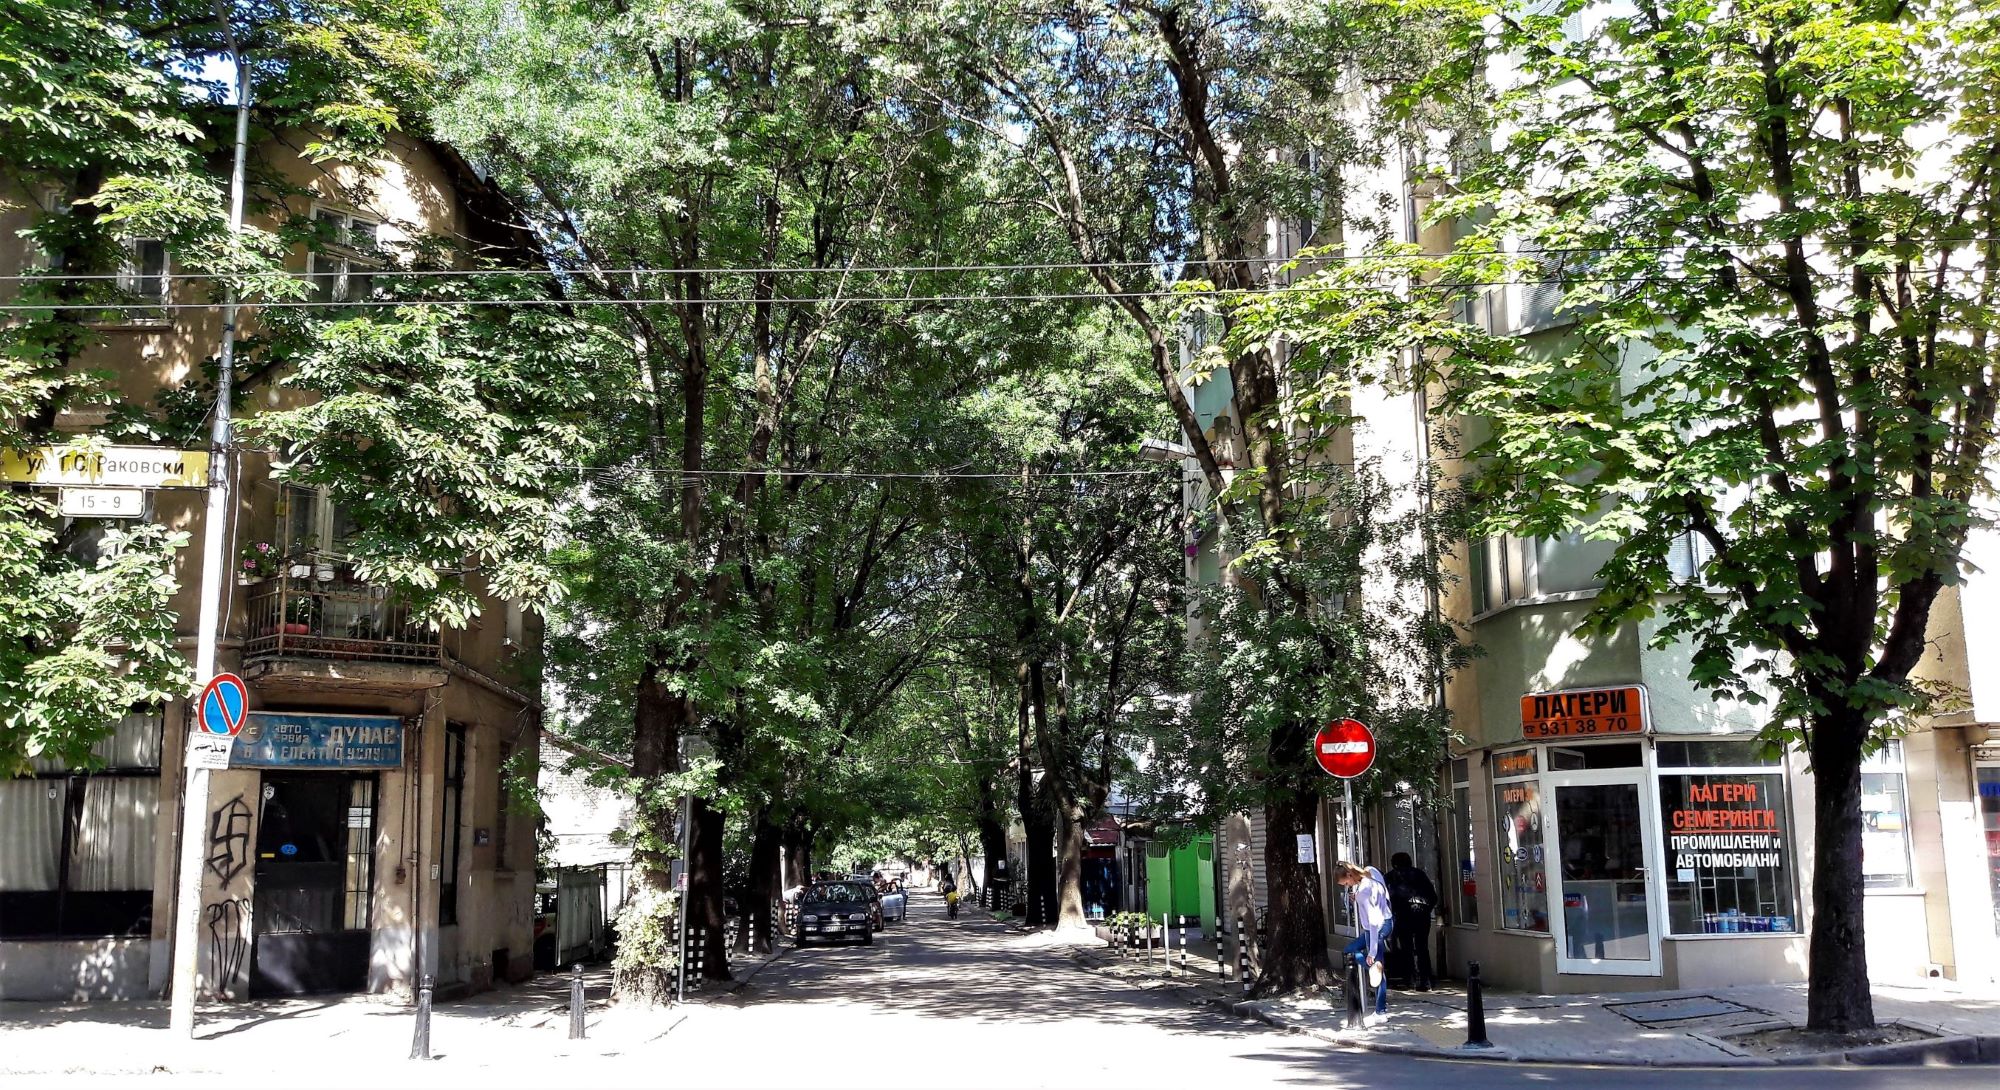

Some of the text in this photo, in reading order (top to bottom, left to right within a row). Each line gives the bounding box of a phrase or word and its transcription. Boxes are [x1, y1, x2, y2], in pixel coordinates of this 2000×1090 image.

[97, 455, 184, 475] Раковски
[82, 495, 95, 509] 15
[113, 496, 121, 509] 9
[1534, 690, 1627, 719] ЛАГЕРИ
[330, 725, 394, 745] ДУНАВ
[1540, 717, 1628, 735] 931 38 70
[1689, 784, 1757, 803] ЛАГЕРИ
[1672, 809, 1777, 828] СЕМЕРИНГИ
[1671, 835, 1770, 850] ПРОМИШЛЕНИ
[1676, 853, 1780, 869] АВТОМОБИЛНИ
